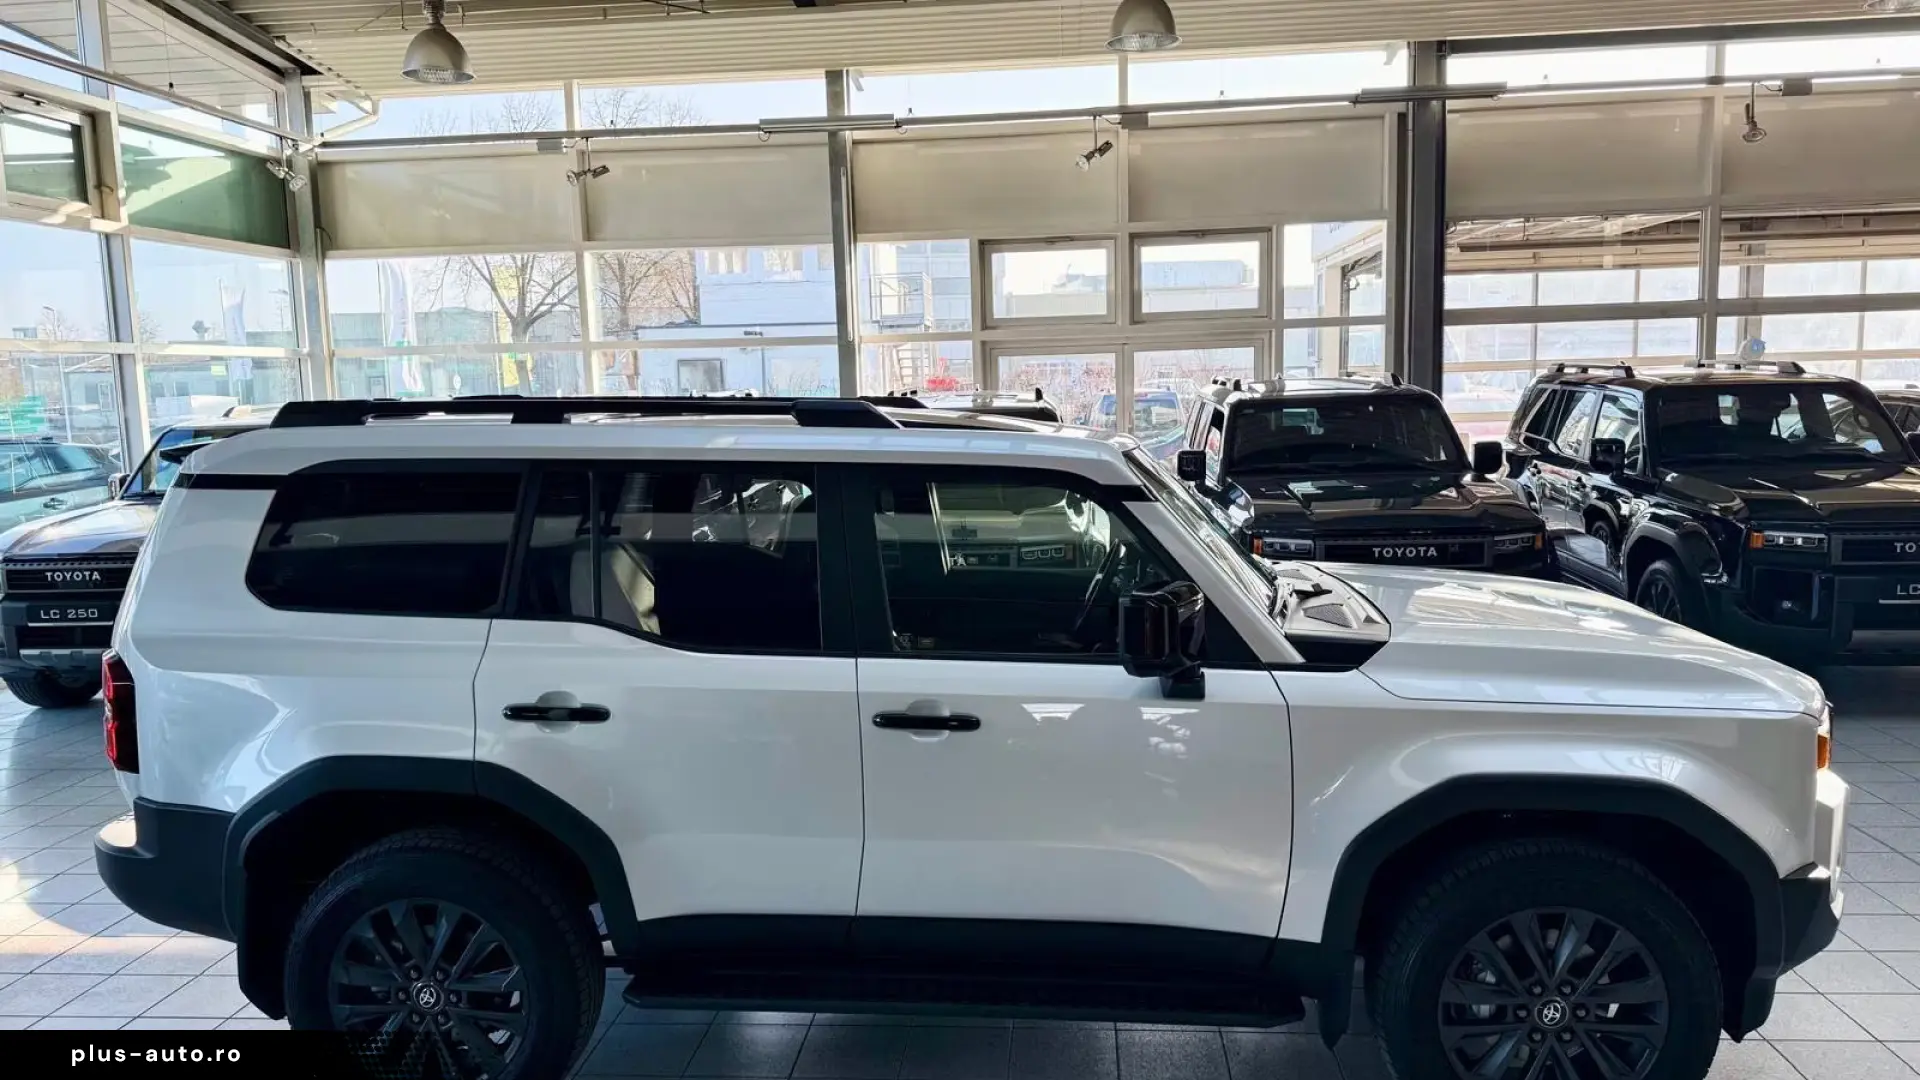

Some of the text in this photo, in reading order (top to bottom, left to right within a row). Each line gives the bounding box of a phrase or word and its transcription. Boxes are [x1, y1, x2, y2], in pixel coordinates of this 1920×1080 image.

[1372, 546, 1438, 558] TOYOTA
[45, 571, 101, 581] TOYOTA
[40, 608, 98, 619] LC 250
